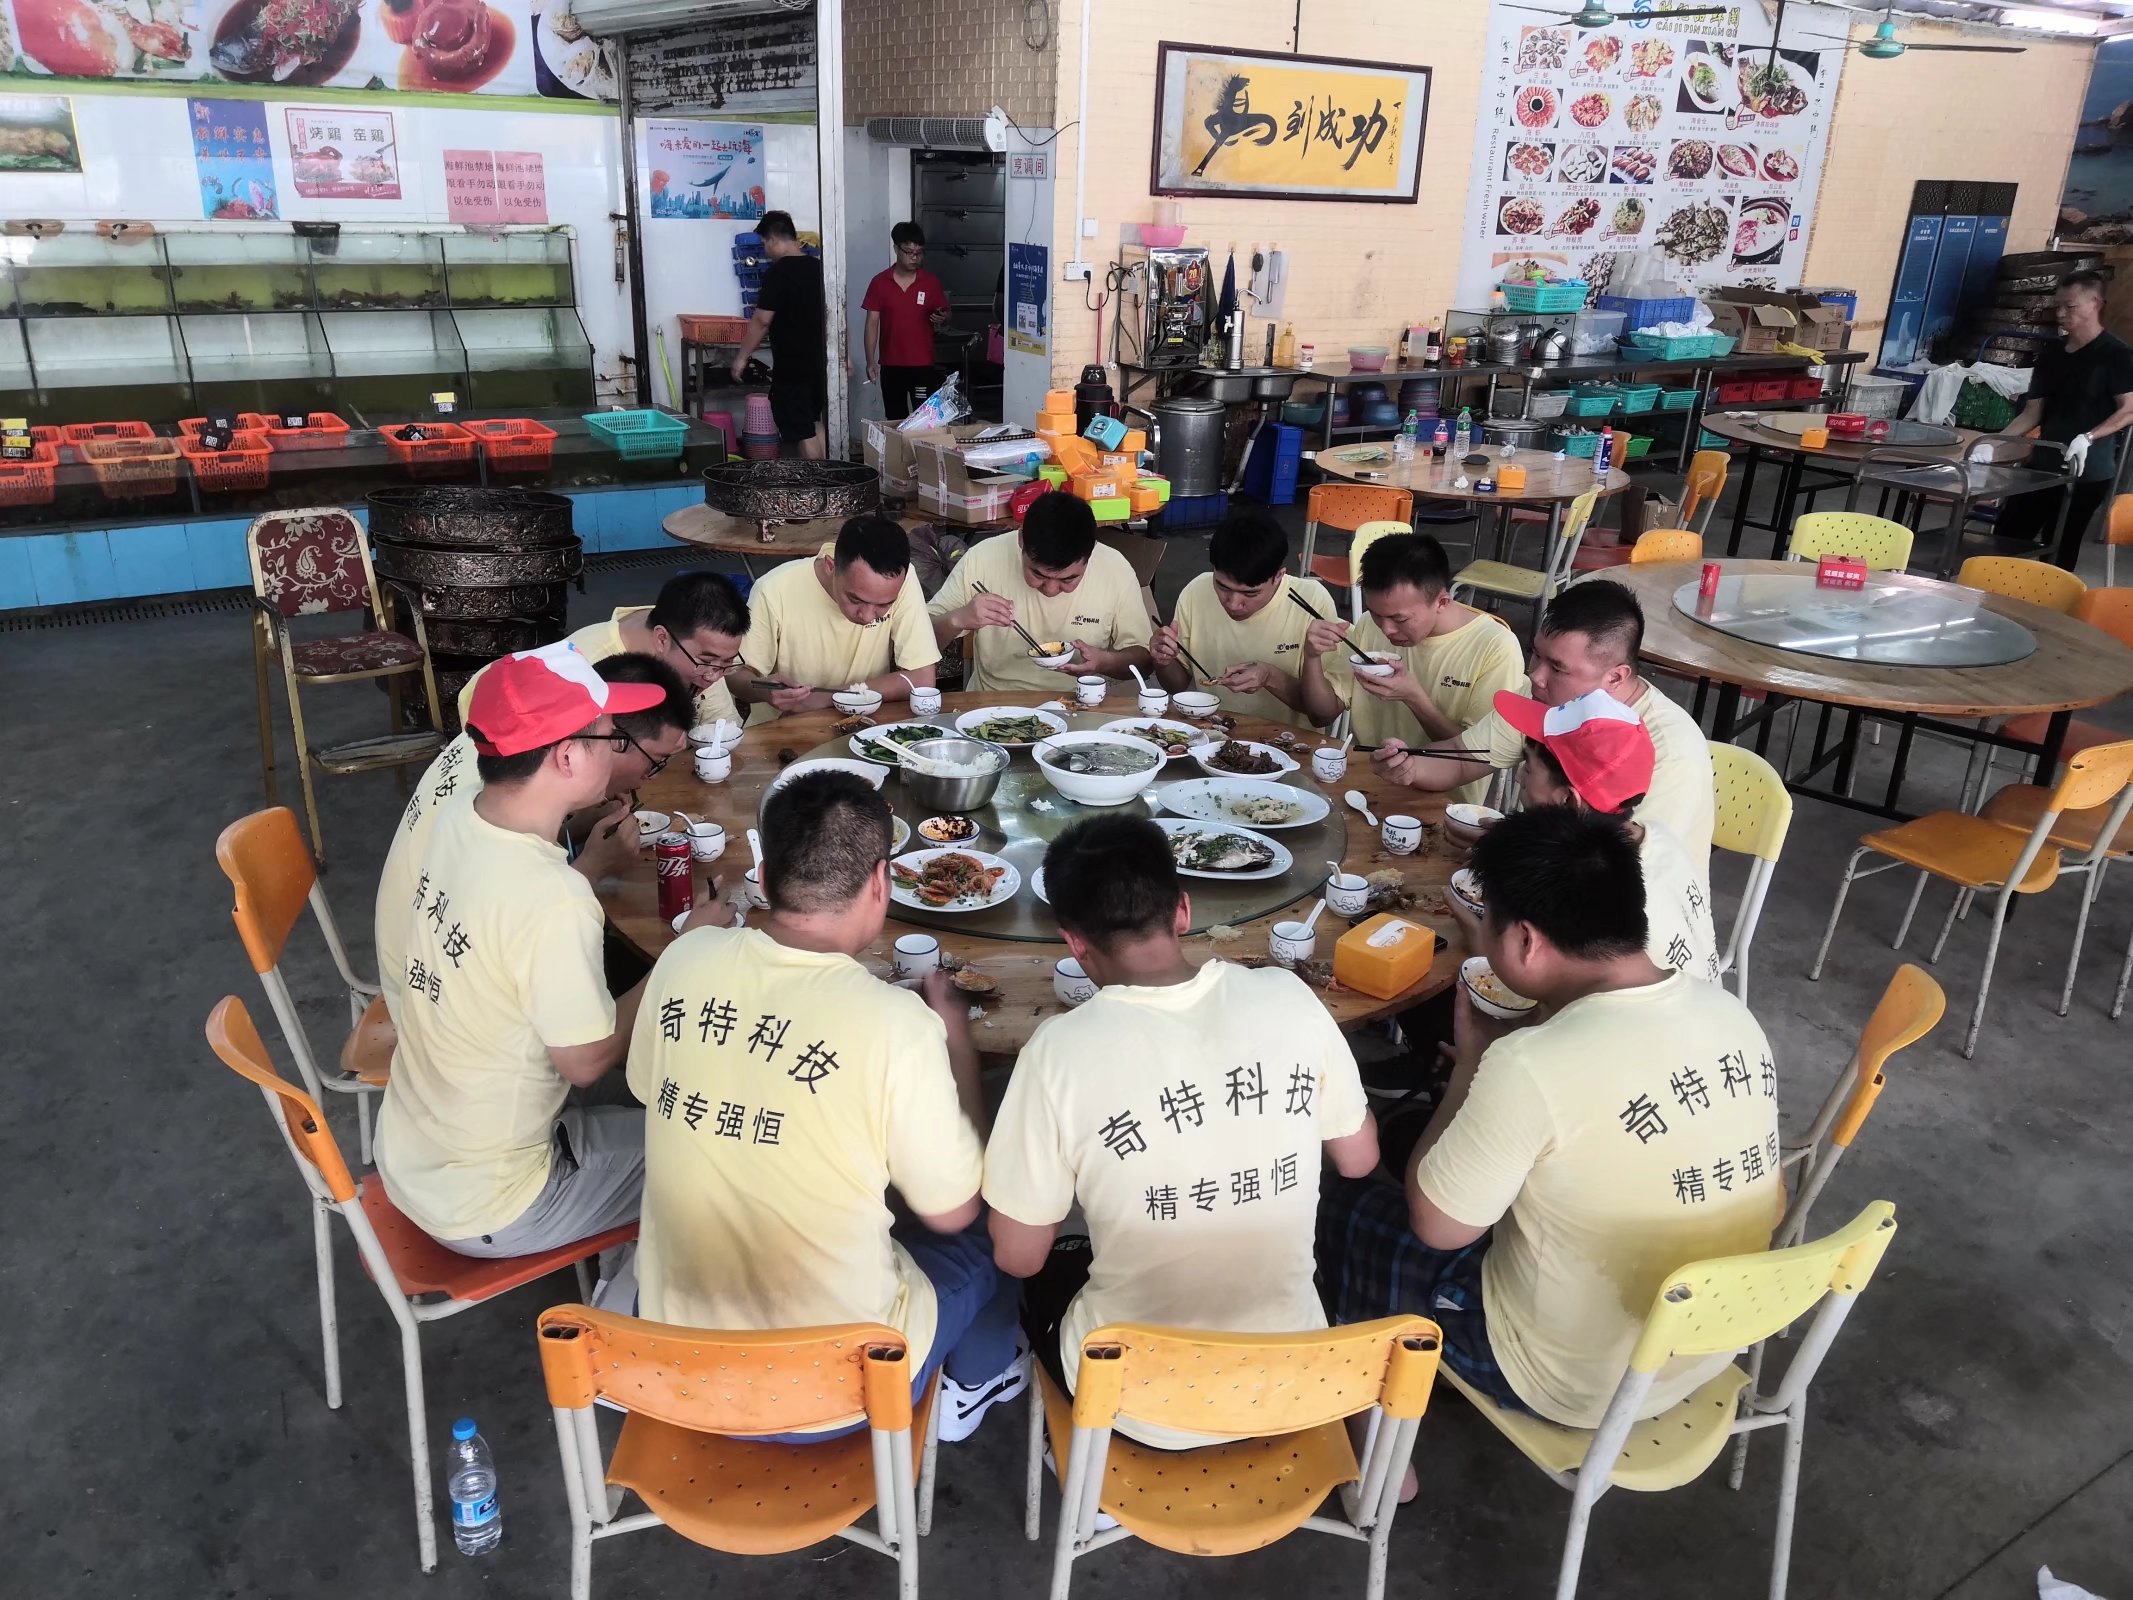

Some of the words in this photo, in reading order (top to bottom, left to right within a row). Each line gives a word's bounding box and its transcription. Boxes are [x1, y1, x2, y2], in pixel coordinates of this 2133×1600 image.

[1656, 21, 1673, 31] CAI
[1684, 24, 1700, 34] PIN
[1701, 26, 1724, 37] XIAN
[1487, 128, 1500, 181] Restaurant
[453, 196, 493, 207] 以免受伤
[504, 197, 542, 208] 以免受伤
[1479, 213, 1487, 239] water
[1483, 184, 1493, 210] Fresh
[660, 997, 840, 1094] 奇特科技
[657, 1076, 785, 1146] 精专强恒
[1098, 1061, 1316, 1161] 奇特科技
[1619, 1049, 1777, 1144] 奇特科技
[1145, 1152, 1298, 1221] 精专强恒
[1672, 1131, 1779, 1205] 精专强恒
